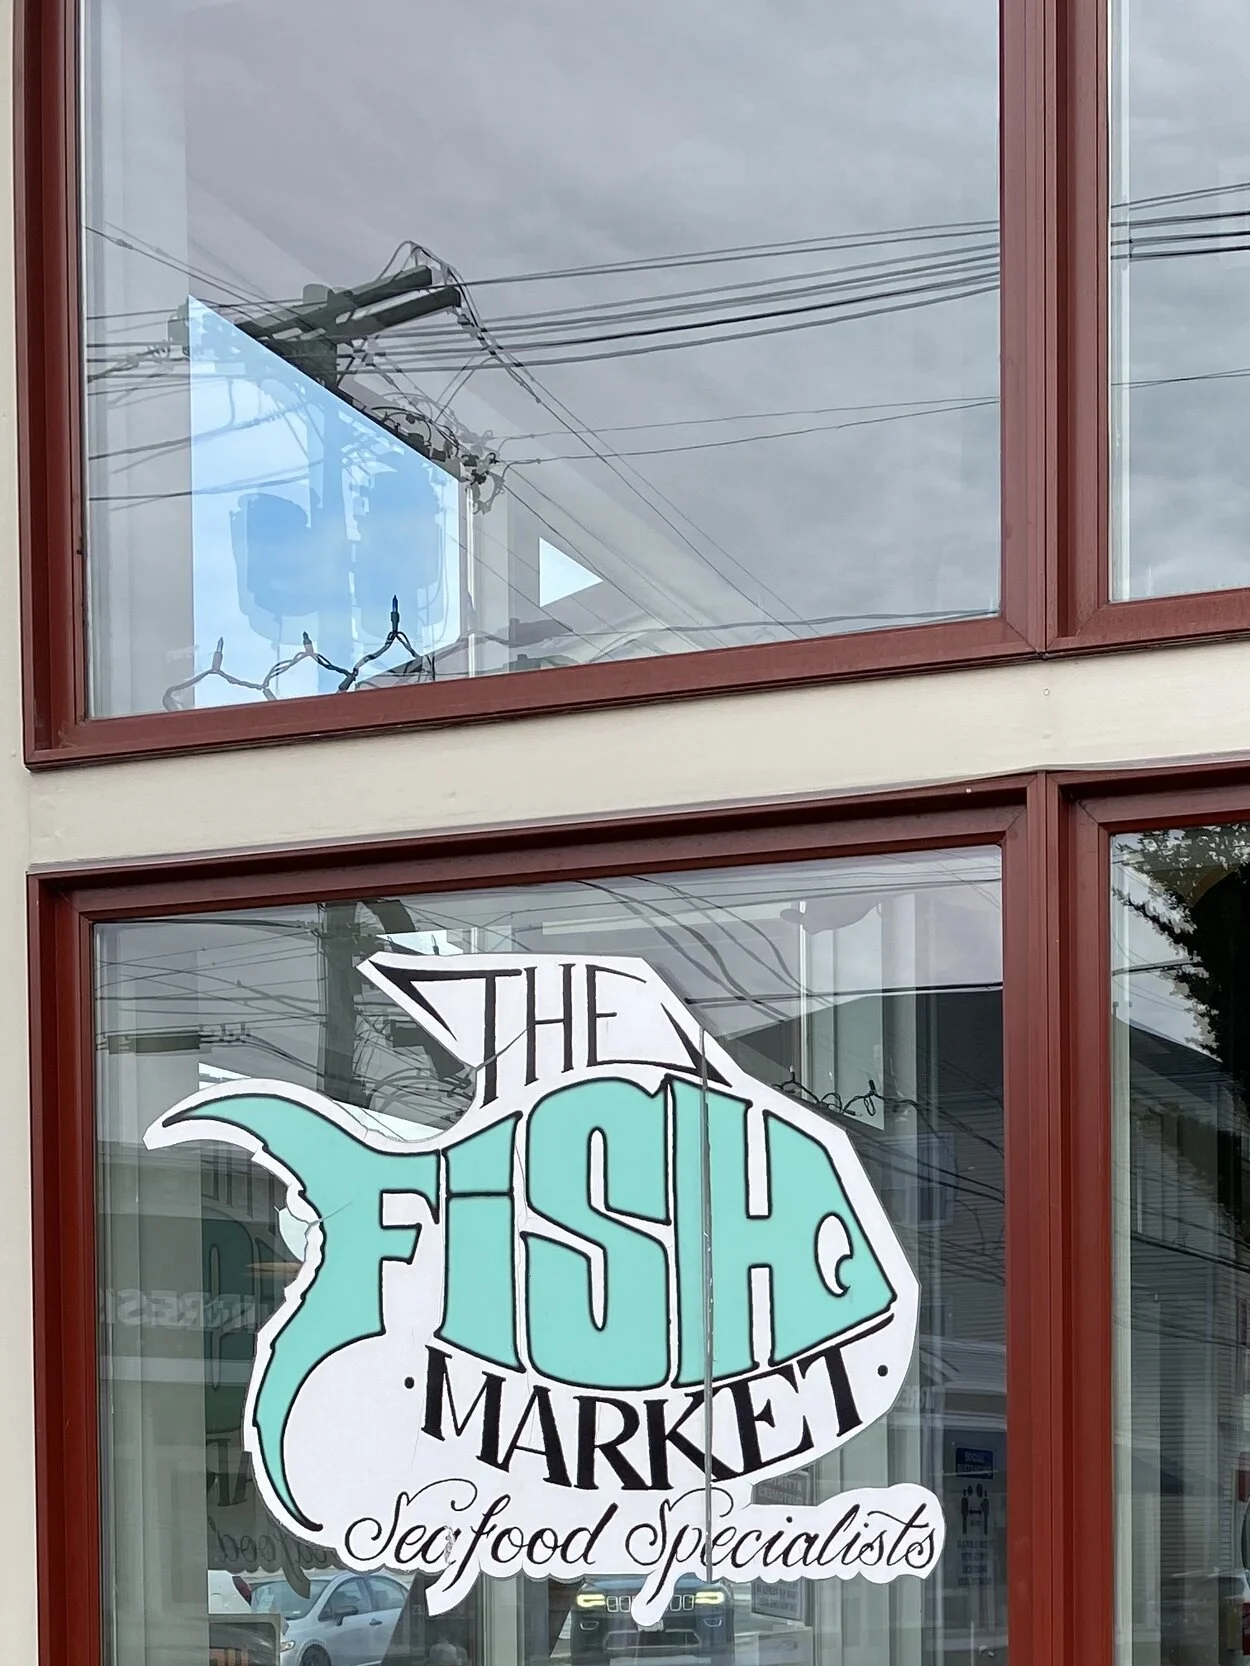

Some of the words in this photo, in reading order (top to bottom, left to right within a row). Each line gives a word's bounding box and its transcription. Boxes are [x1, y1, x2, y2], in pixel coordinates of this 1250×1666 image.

[409, 962, 653, 1108] THE
[420, 1315, 896, 1492] MARKET
[344, 1479, 618, 1608] Seafood
[625, 1486, 938, 1618] Specialists
